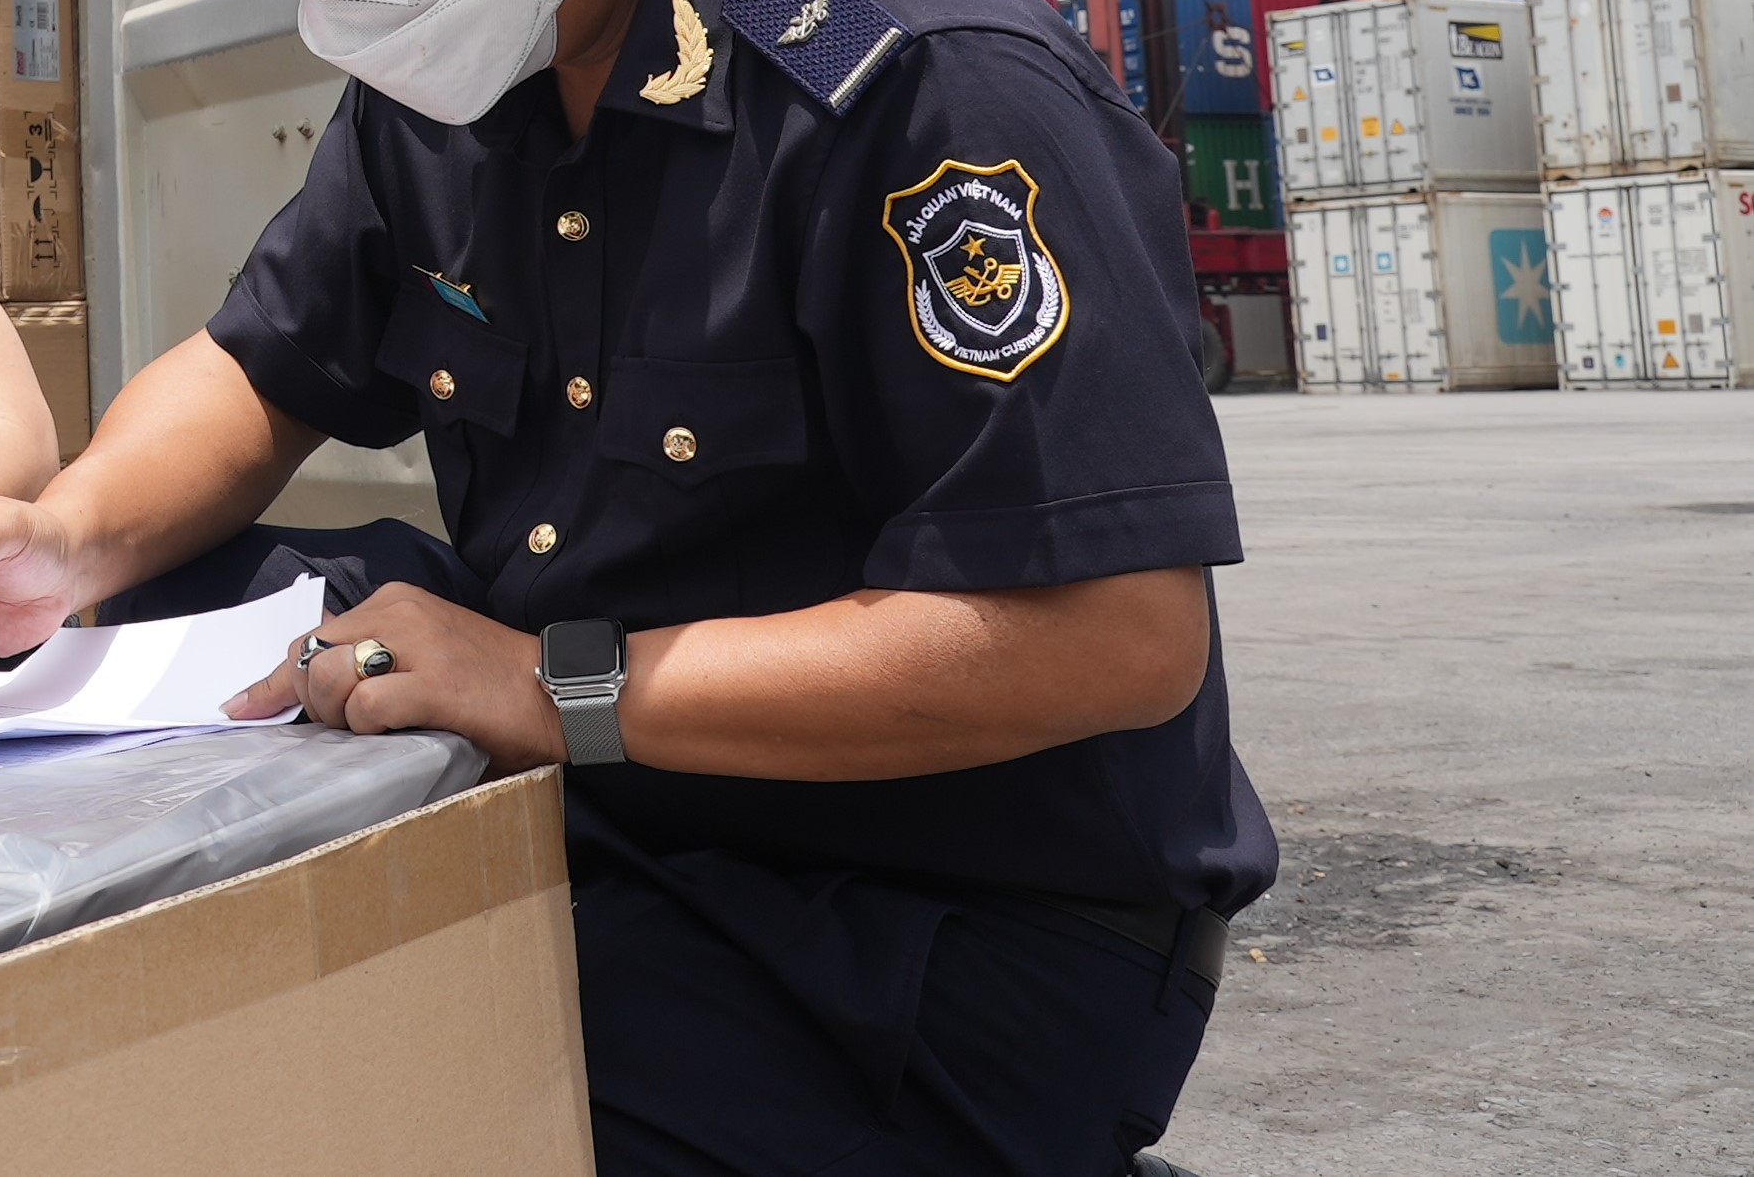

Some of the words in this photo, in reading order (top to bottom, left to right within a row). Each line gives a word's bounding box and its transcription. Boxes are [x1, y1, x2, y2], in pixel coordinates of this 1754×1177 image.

[1212, 26, 1254, 79] S
[29, 124, 43, 136] 3
[1222, 159, 1266, 211] H
[906, 215, 927, 245] HẢI
[921, 187, 959, 221] QUAN
[958, 178, 991, 201] VIỆT
[990, 191, 1023, 222] NAM
[953, 344, 1001, 363] VIETNAM
[1001, 326, 1047, 358] CUSTOMS
